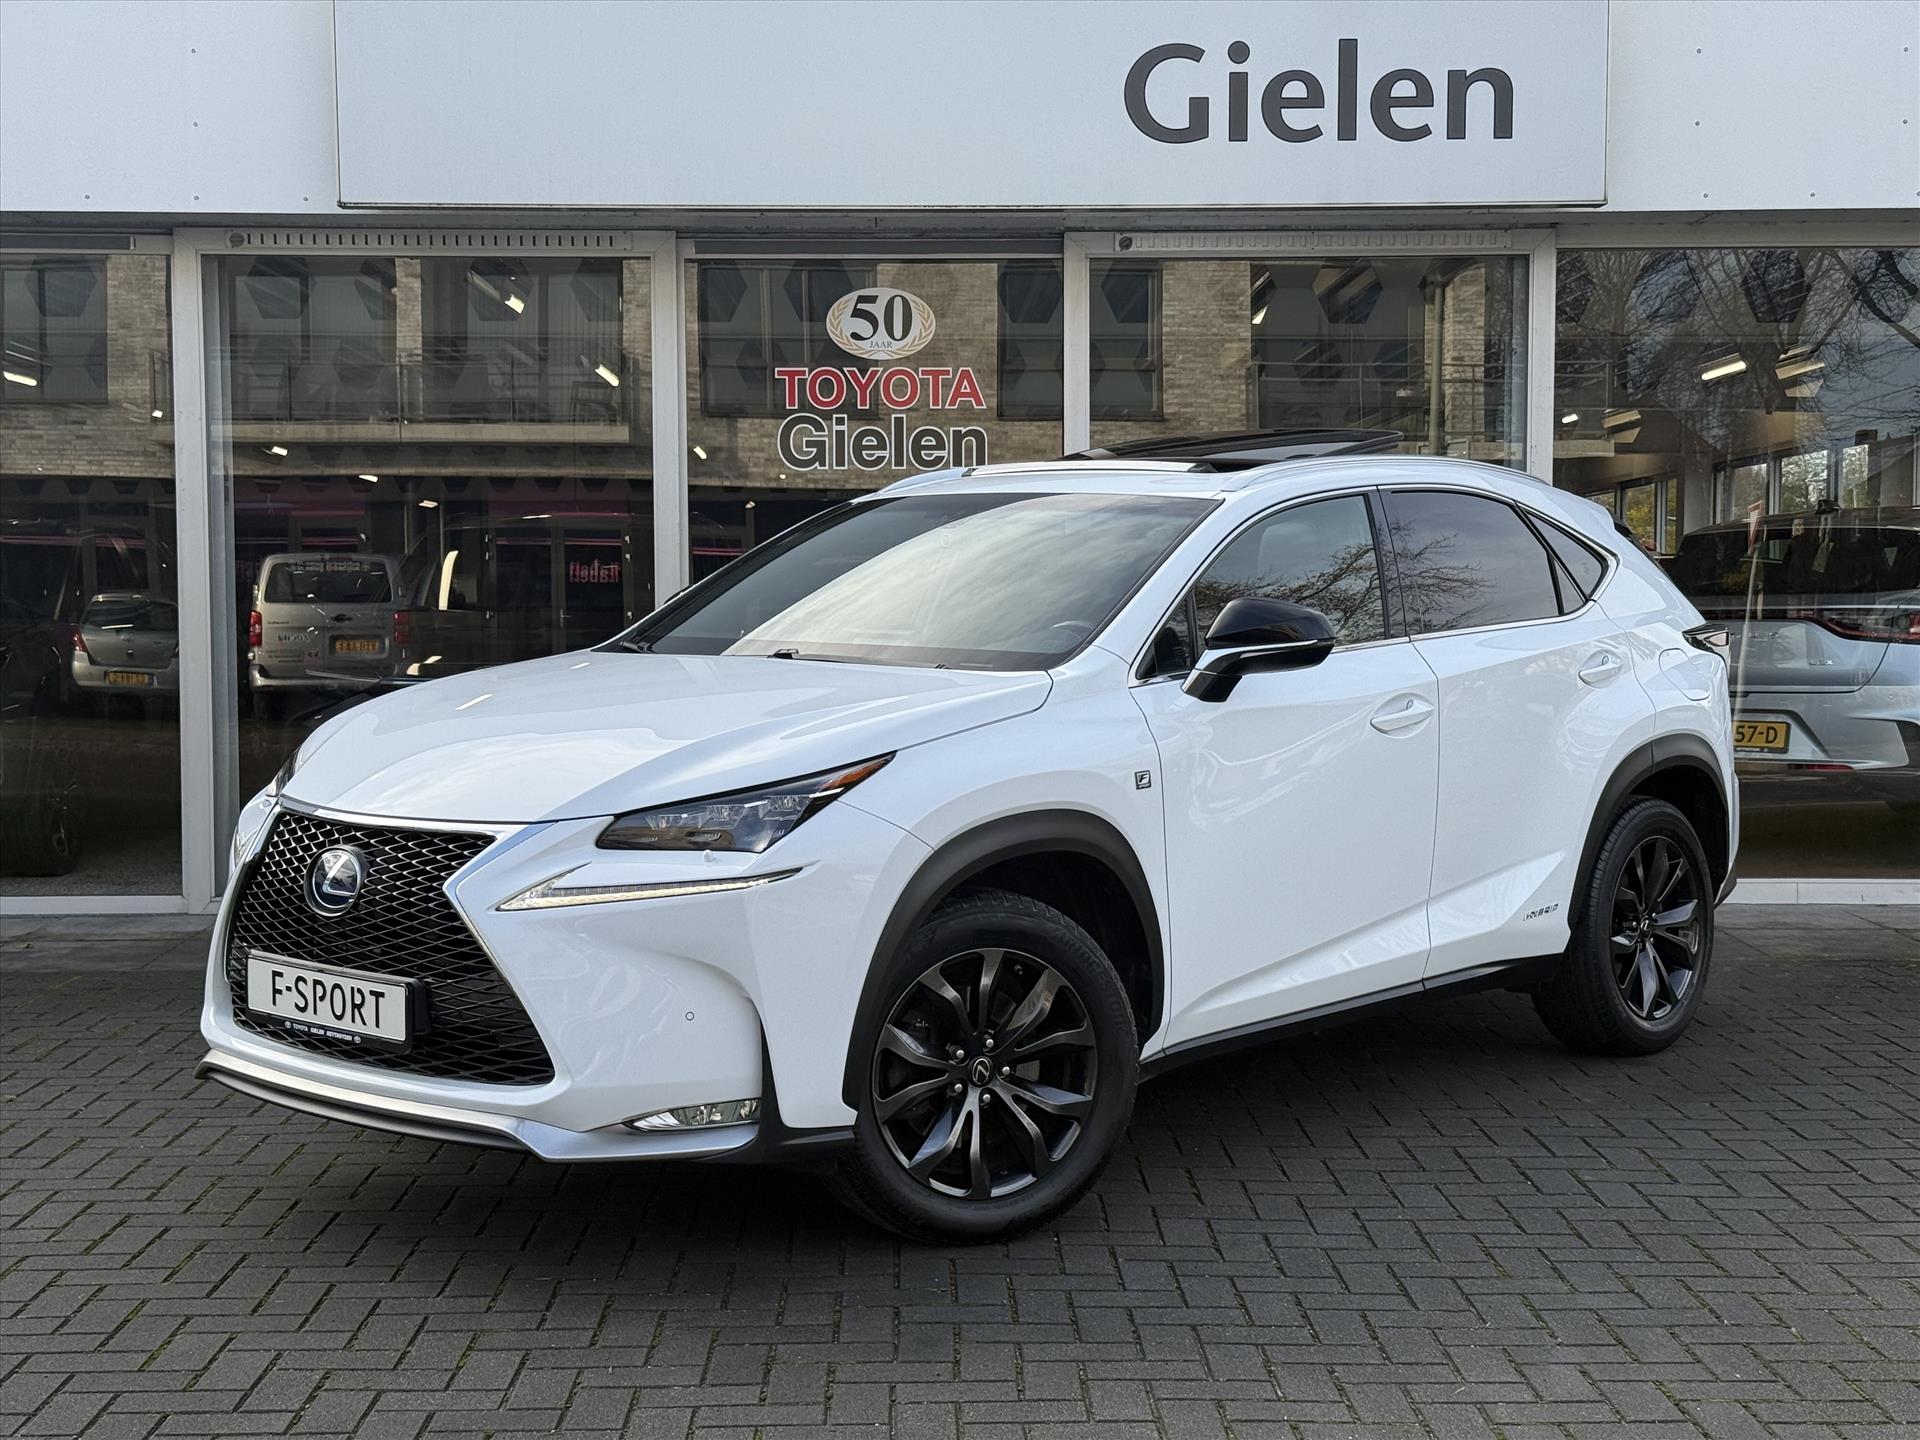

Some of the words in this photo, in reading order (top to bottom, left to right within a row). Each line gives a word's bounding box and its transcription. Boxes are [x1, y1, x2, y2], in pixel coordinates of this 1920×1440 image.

[1123, 38, 1514, 144] Gielen
[849, 294, 913, 342] 50
[868, 340, 893, 349] JAAR
[775, 367, 987, 409] TOYOTA
[777, 413, 988, 470] Gielen
[1734, 725, 1778, 744] 57-D
[272, 969, 386, 1029] F-SPORT
